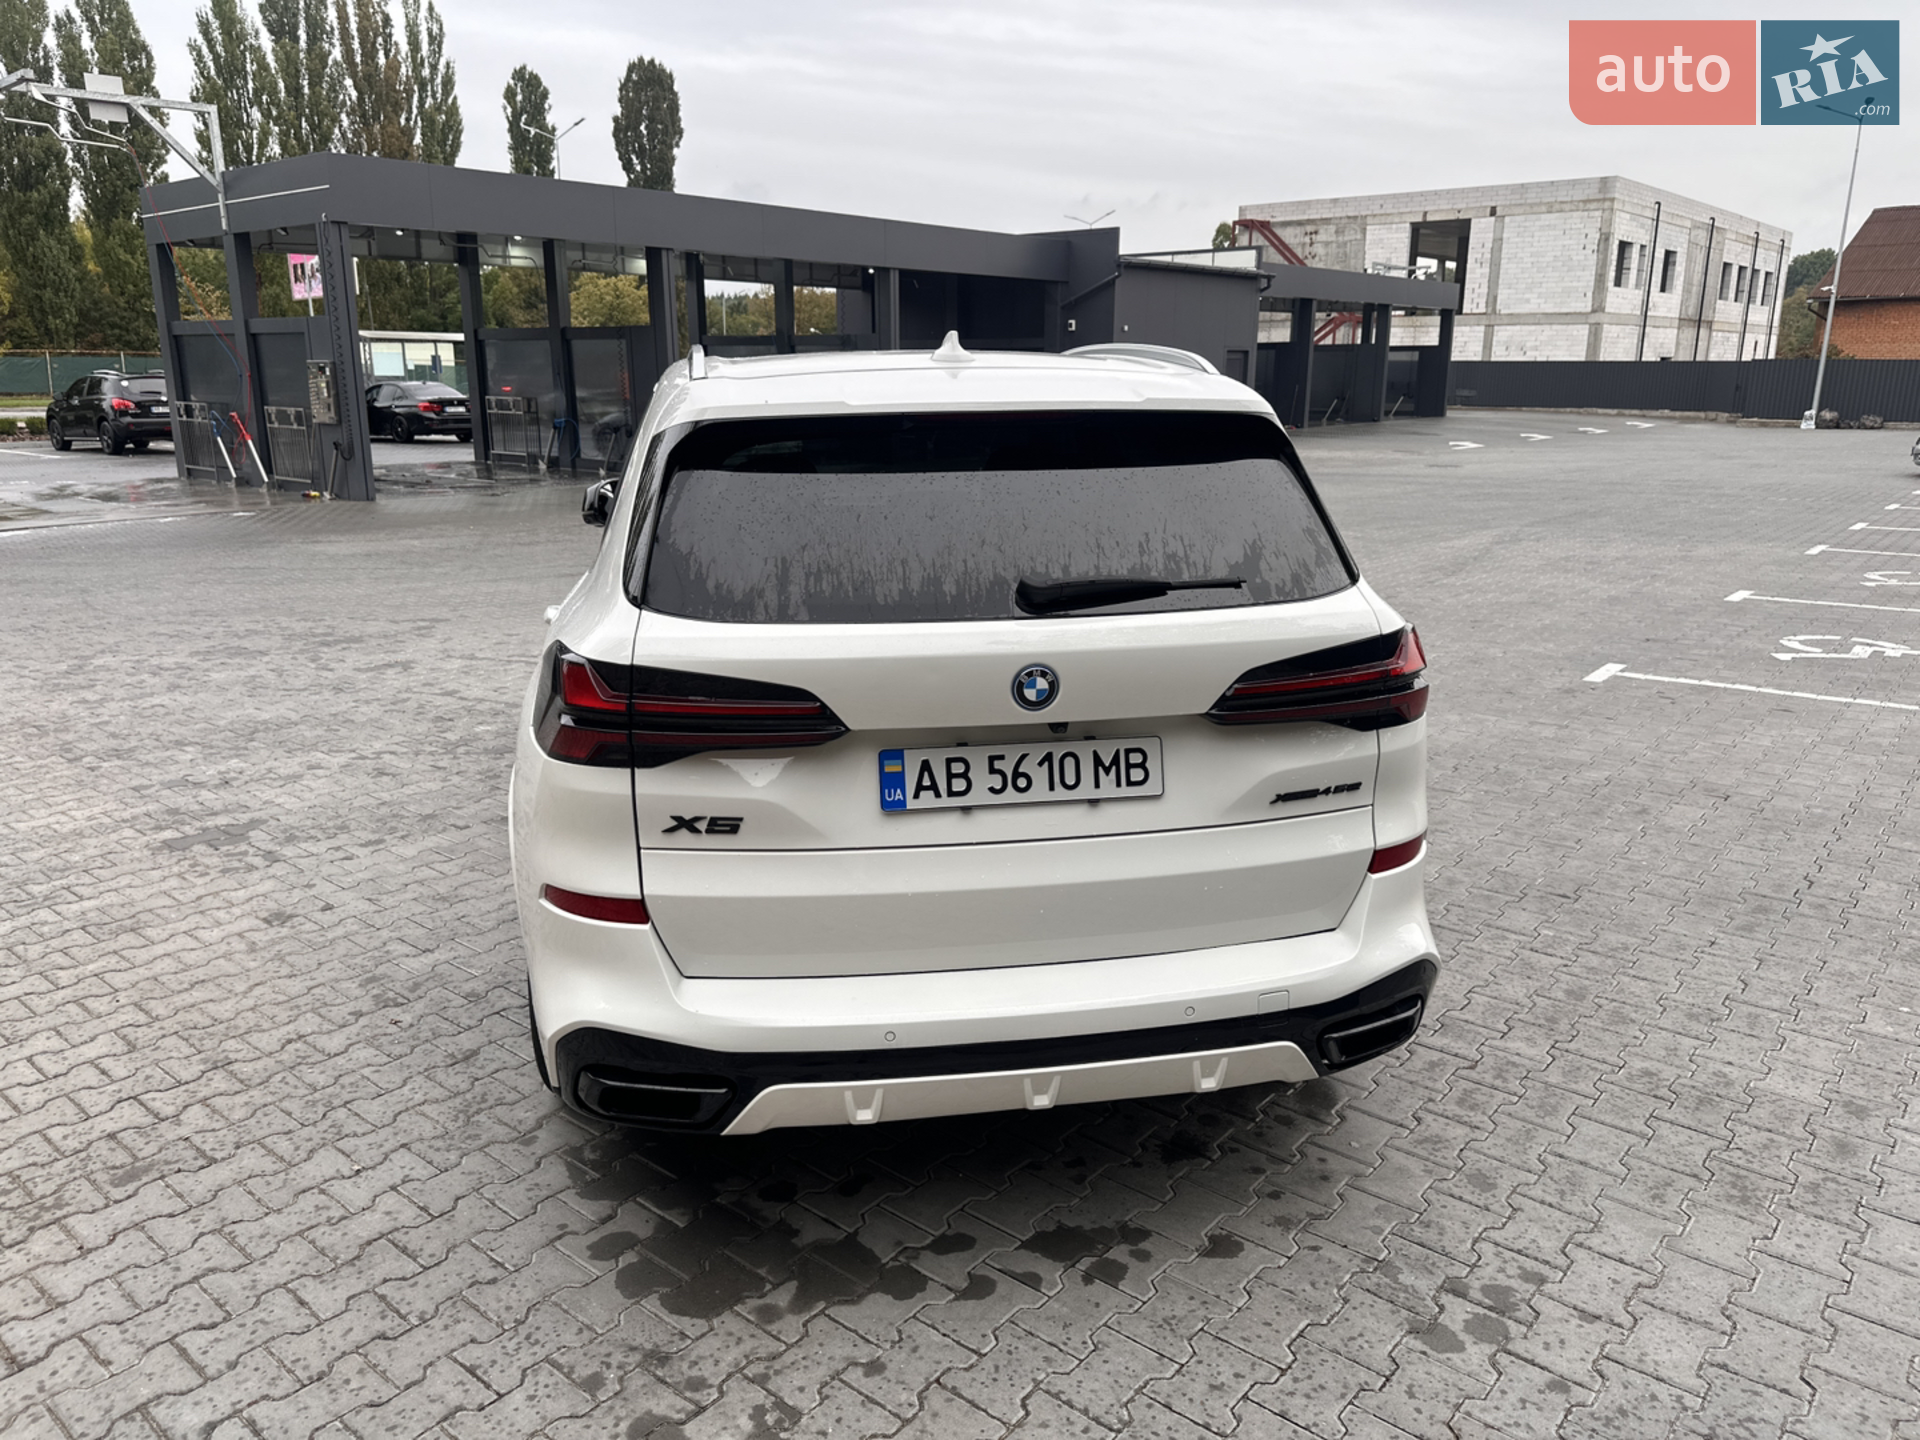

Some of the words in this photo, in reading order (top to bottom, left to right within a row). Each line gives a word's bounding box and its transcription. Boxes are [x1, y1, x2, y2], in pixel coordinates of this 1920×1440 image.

[1019, 669, 1055, 683] BMW
[912, 756, 973, 799] AB
[987, 750, 1082, 795] 5610
[1092, 747, 1151, 789] MB
[885, 789, 904, 801] UA
[661, 815, 744, 834] X5
